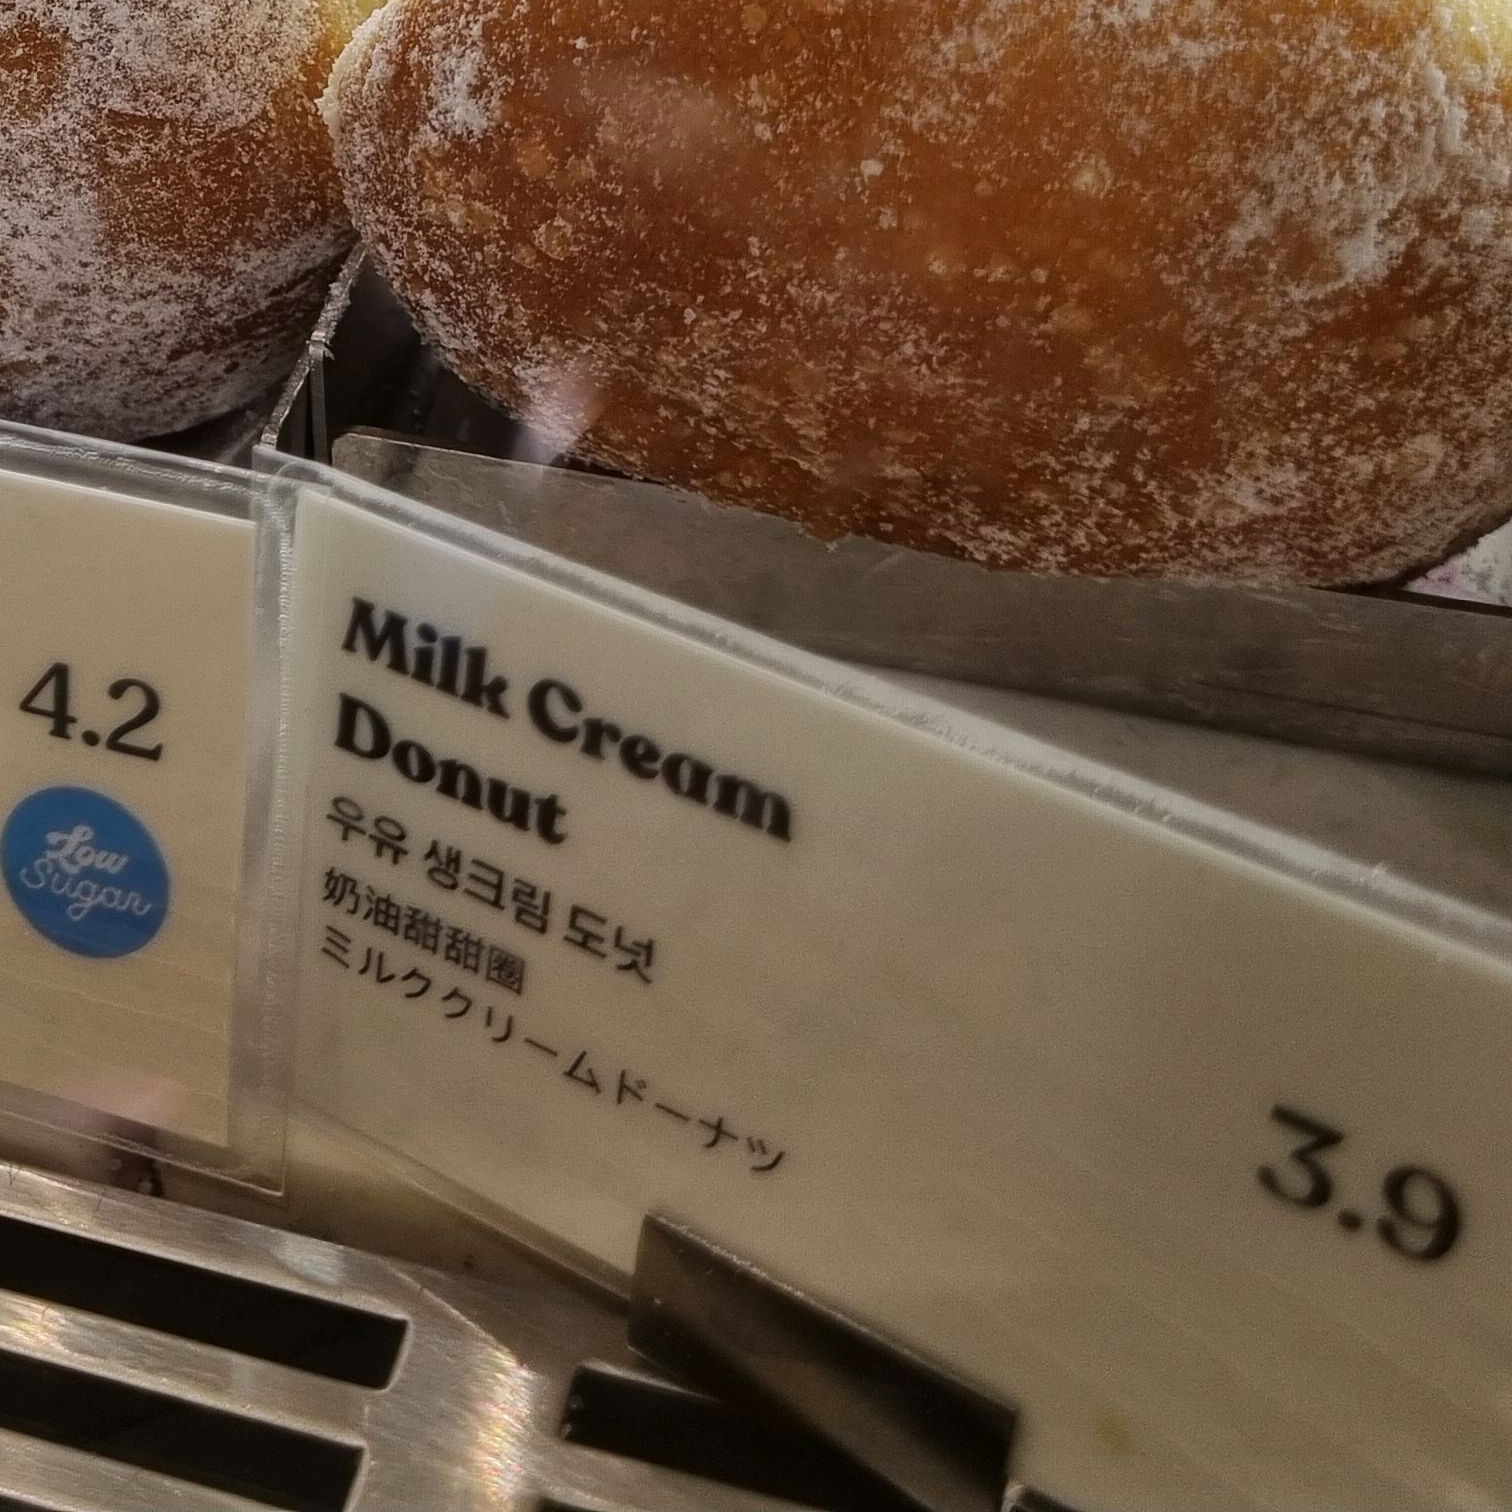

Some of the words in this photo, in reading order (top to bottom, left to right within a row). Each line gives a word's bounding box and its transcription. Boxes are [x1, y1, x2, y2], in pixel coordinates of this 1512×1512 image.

[19, 661, 163, 761] 4.2
[334, 692, 568, 845] Donut
[341, 597, 511, 718] Milk
[527, 678, 793, 842] Cream
[20, 857, 152, 921] Sugar
[46, 824, 128, 874] Low
[326, 796, 409, 865] 우유
[424, 840, 551, 935] 생크림
[563, 904, 653, 984] 도넛
[322, 867, 525, 996] 奶油甜甜圈
[321, 925, 785, 1174] ミルククリームドーナツ
[1257, 1103, 1463, 1264] 3.9
